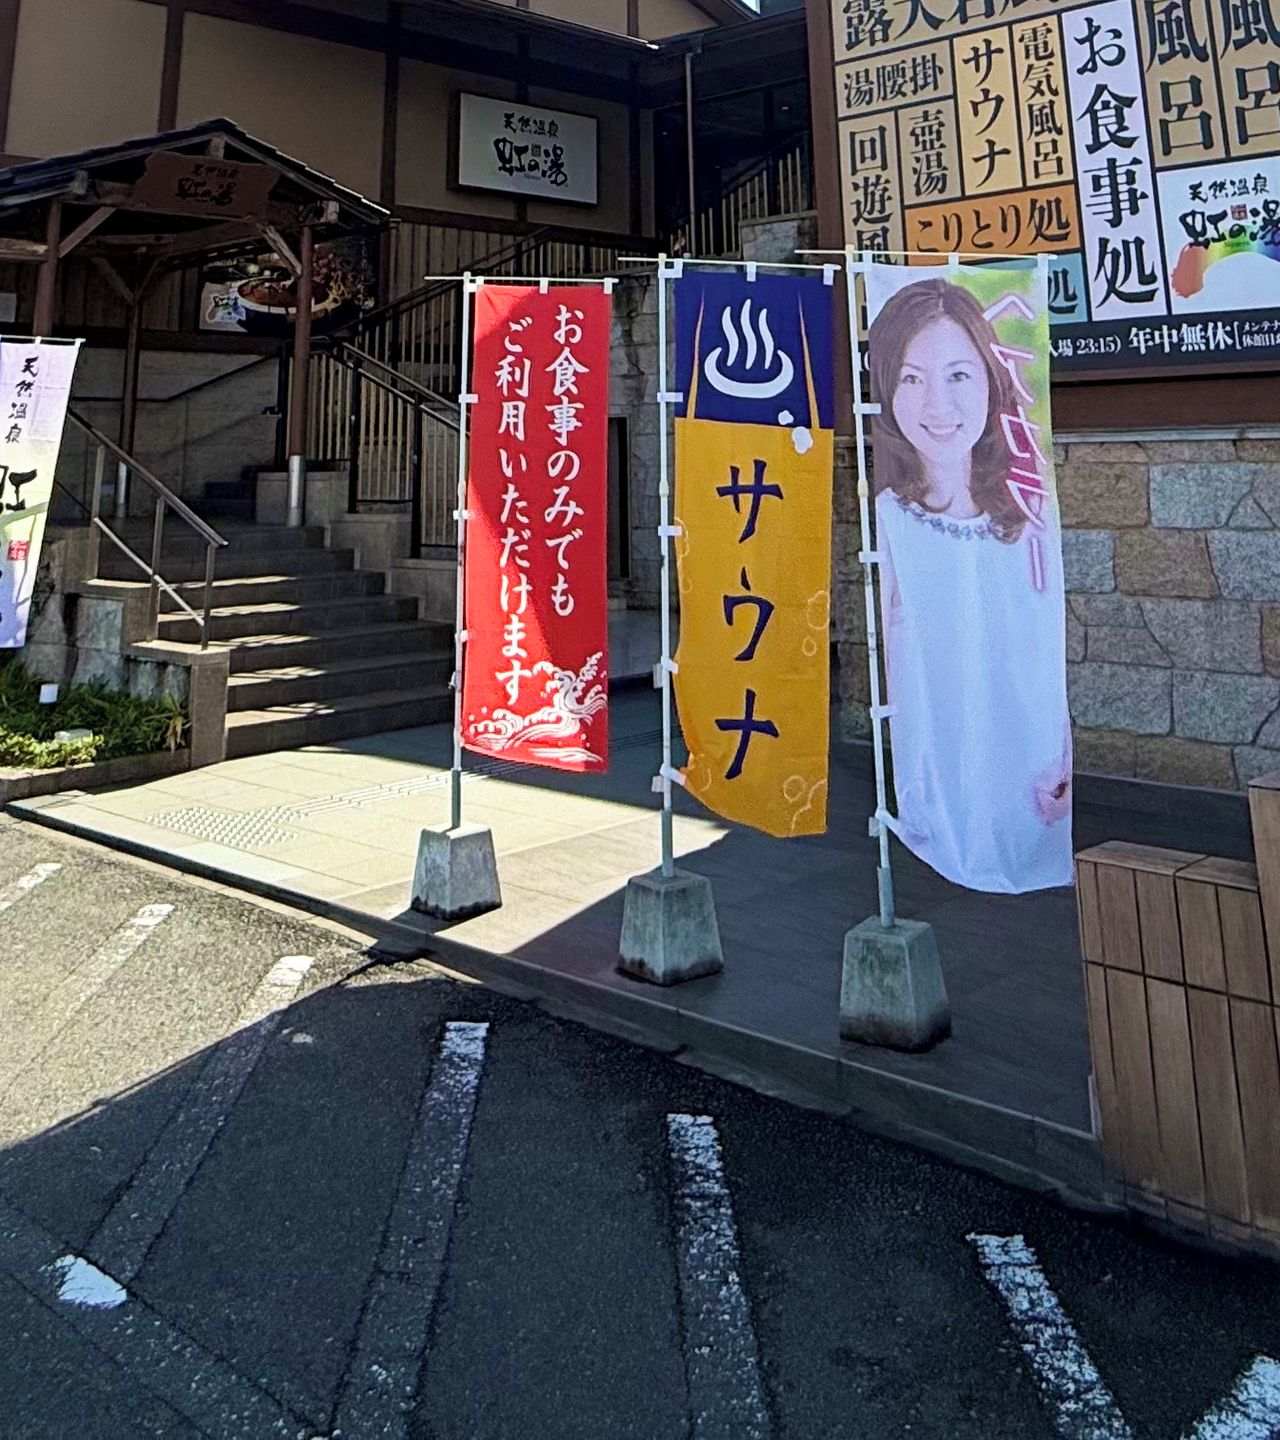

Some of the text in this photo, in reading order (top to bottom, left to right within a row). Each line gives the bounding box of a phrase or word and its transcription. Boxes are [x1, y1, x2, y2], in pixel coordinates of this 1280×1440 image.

[843, 52, 944, 109] 湯腰掛
[962, 38, 1012, 189] サウナ
[1018, 22, 1064, 180] 電気風呂
[848, 124, 897, 265] 回遊風
[1073, 16, 1159, 310] お食事処
[1127, 320, 1234, 355] 年中無休
[494, 315, 534, 706] ご利用いただけます
[544, 304, 590, 617] お食事のみでも
[713, 458, 785, 781] サウナ
